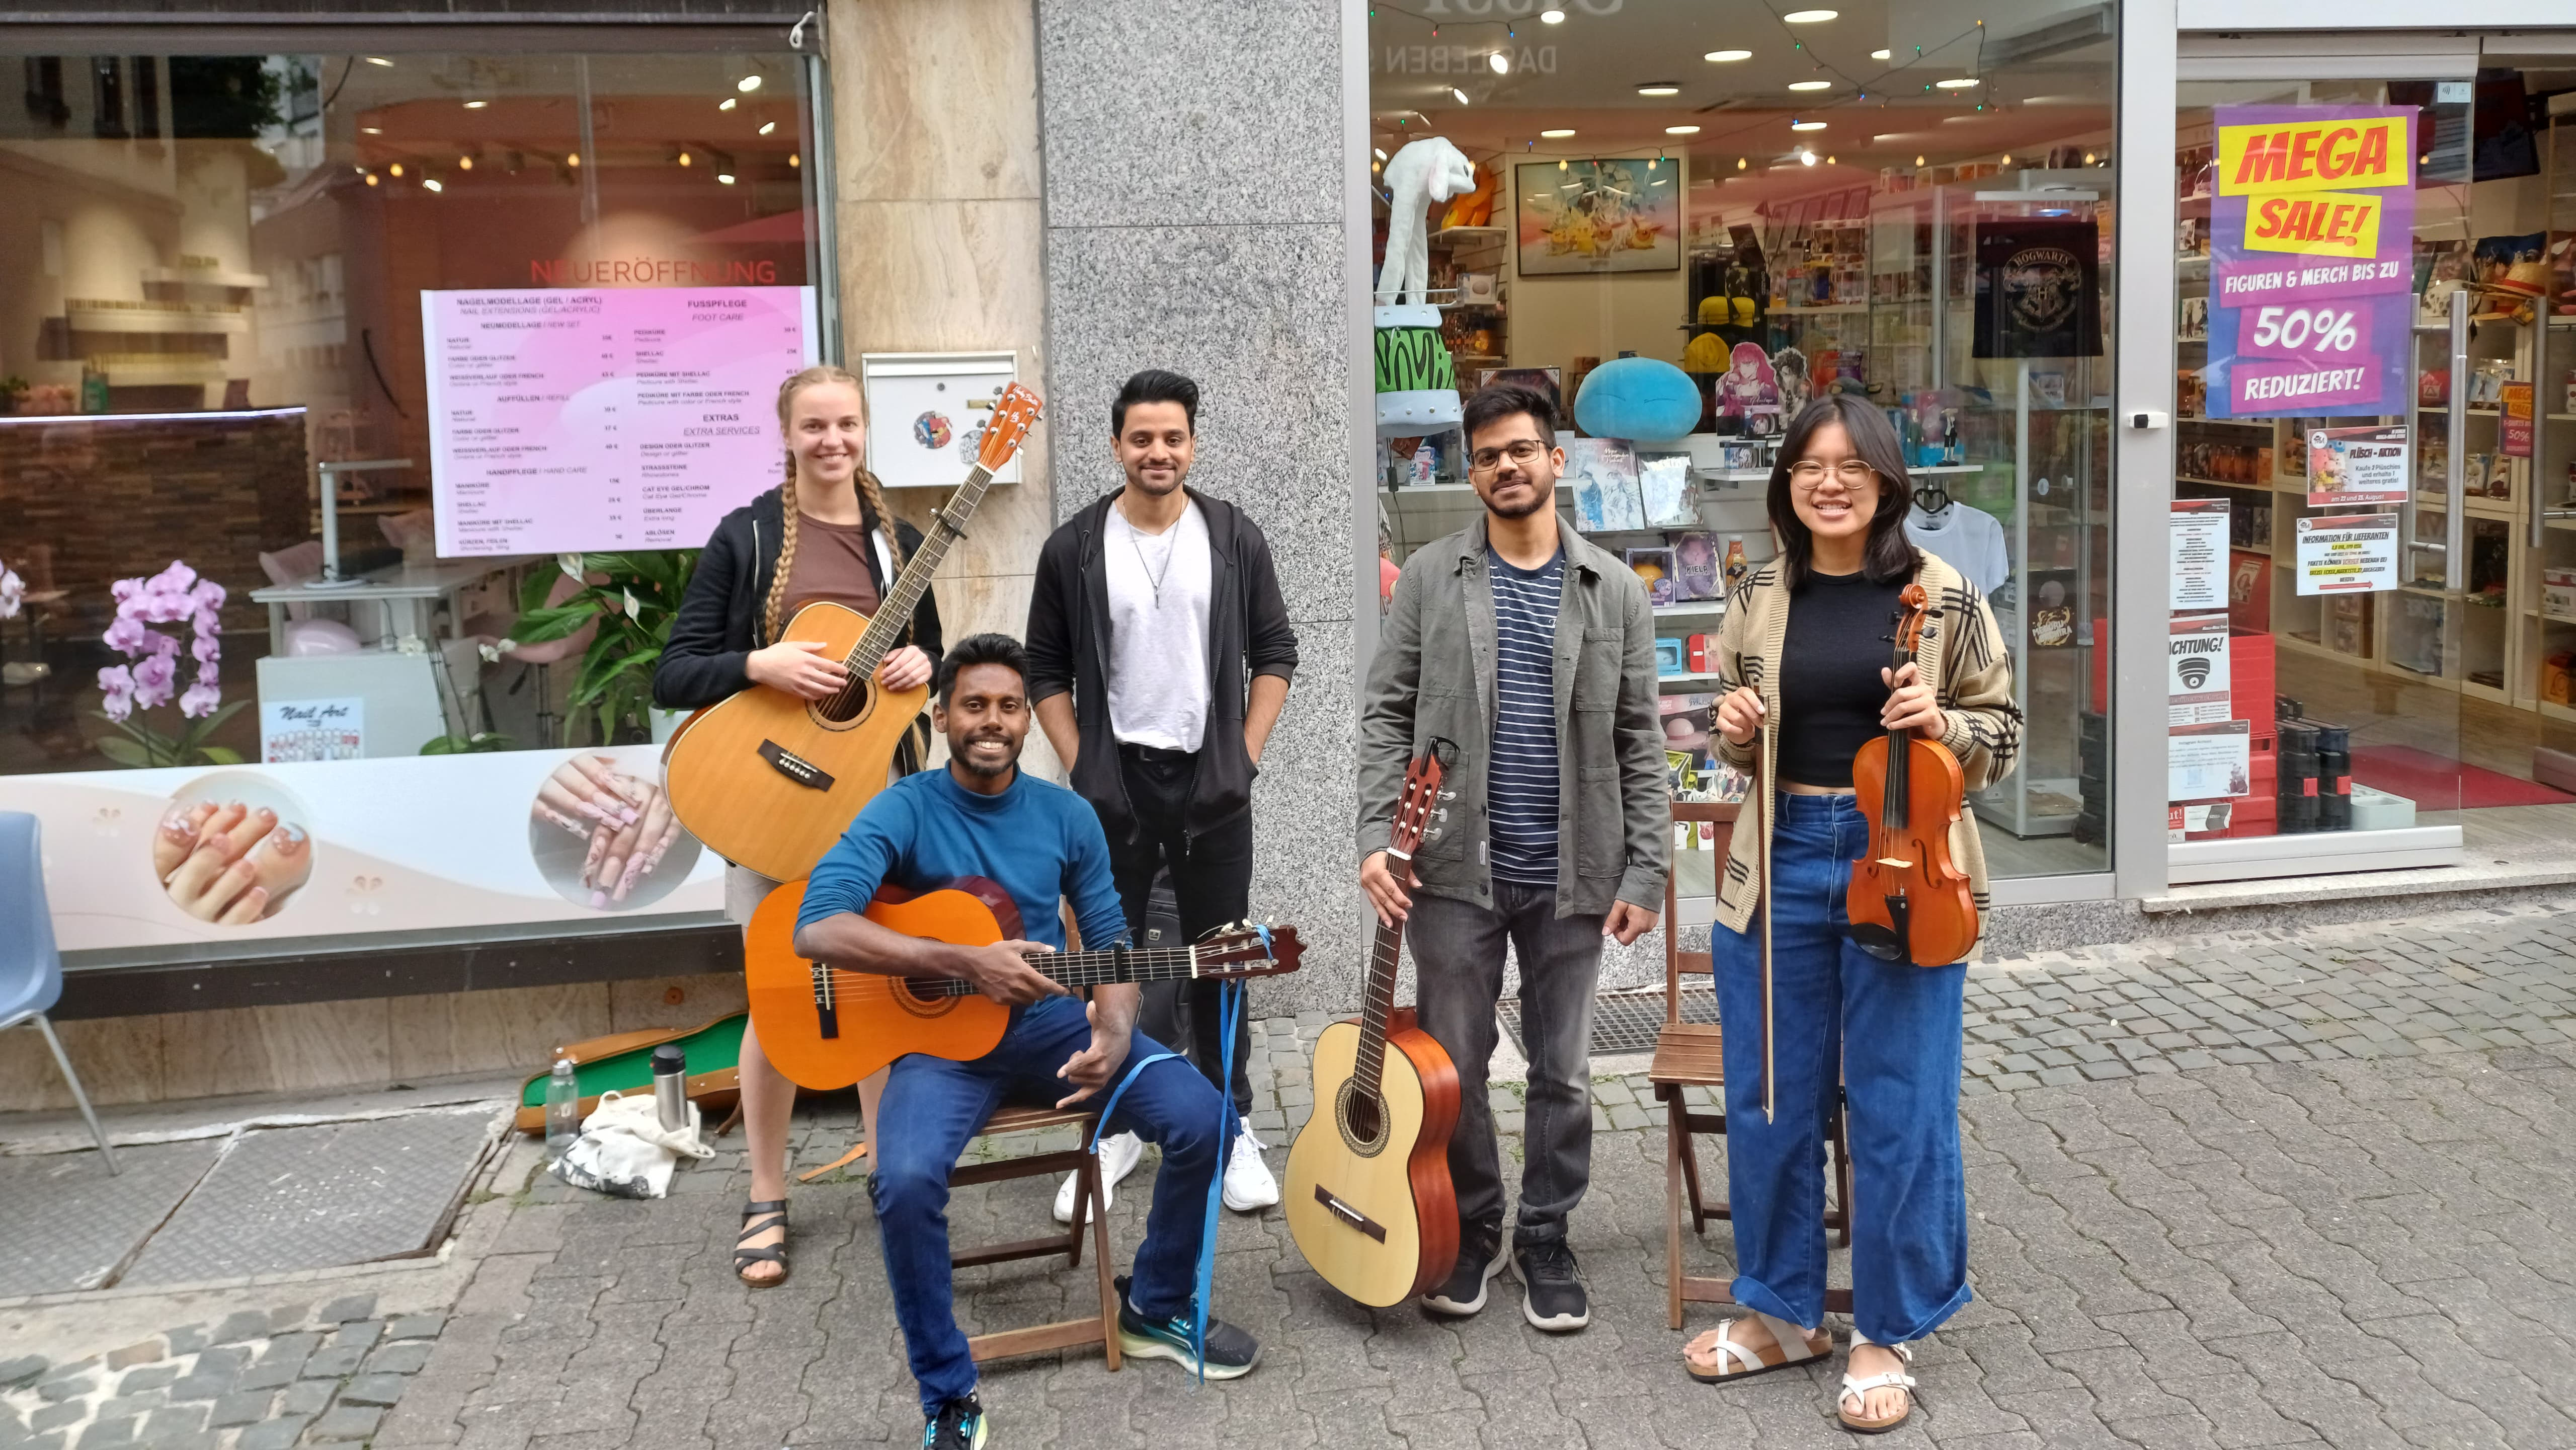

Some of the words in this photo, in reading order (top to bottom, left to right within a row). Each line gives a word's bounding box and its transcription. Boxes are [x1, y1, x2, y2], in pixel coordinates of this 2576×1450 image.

[2234, 126, 2388, 184] MEGA
[2255, 199, 2372, 247] SALE!
[2014, 251, 2070, 267] HOGWARTS
[531, 257, 775, 283] NEUERÖFFNUNG
[2225, 271, 2283, 293] FIGUREN
[2286, 270, 2297, 287] &
[2301, 266, 2348, 286] MERCH
[2353, 264, 2375, 279] BIS
[2380, 261, 2399, 277] ZU
[457, 297, 540, 306] NAGELMODELLAGE
[2253, 306, 2358, 352] 50%
[2244, 367, 2365, 401] REDUZIERT!
[2507, 388, 2531, 400] MEG
[703, 414, 739, 422] EXTRAS
[683, 428, 713, 436] EXTRA
[715, 426, 760, 435] SERVICES
[2508, 429, 2530, 442] 50%
[2350, 447, 2373, 459] PLÜSCH
[2302, 534, 2341, 544] INFORMATION
[2342, 532, 2353, 542] FÜR
[2354, 531, 2389, 541] LIEFERANTEN
[280, 706, 317, 721] Nail
[318, 704, 349, 718] Art
